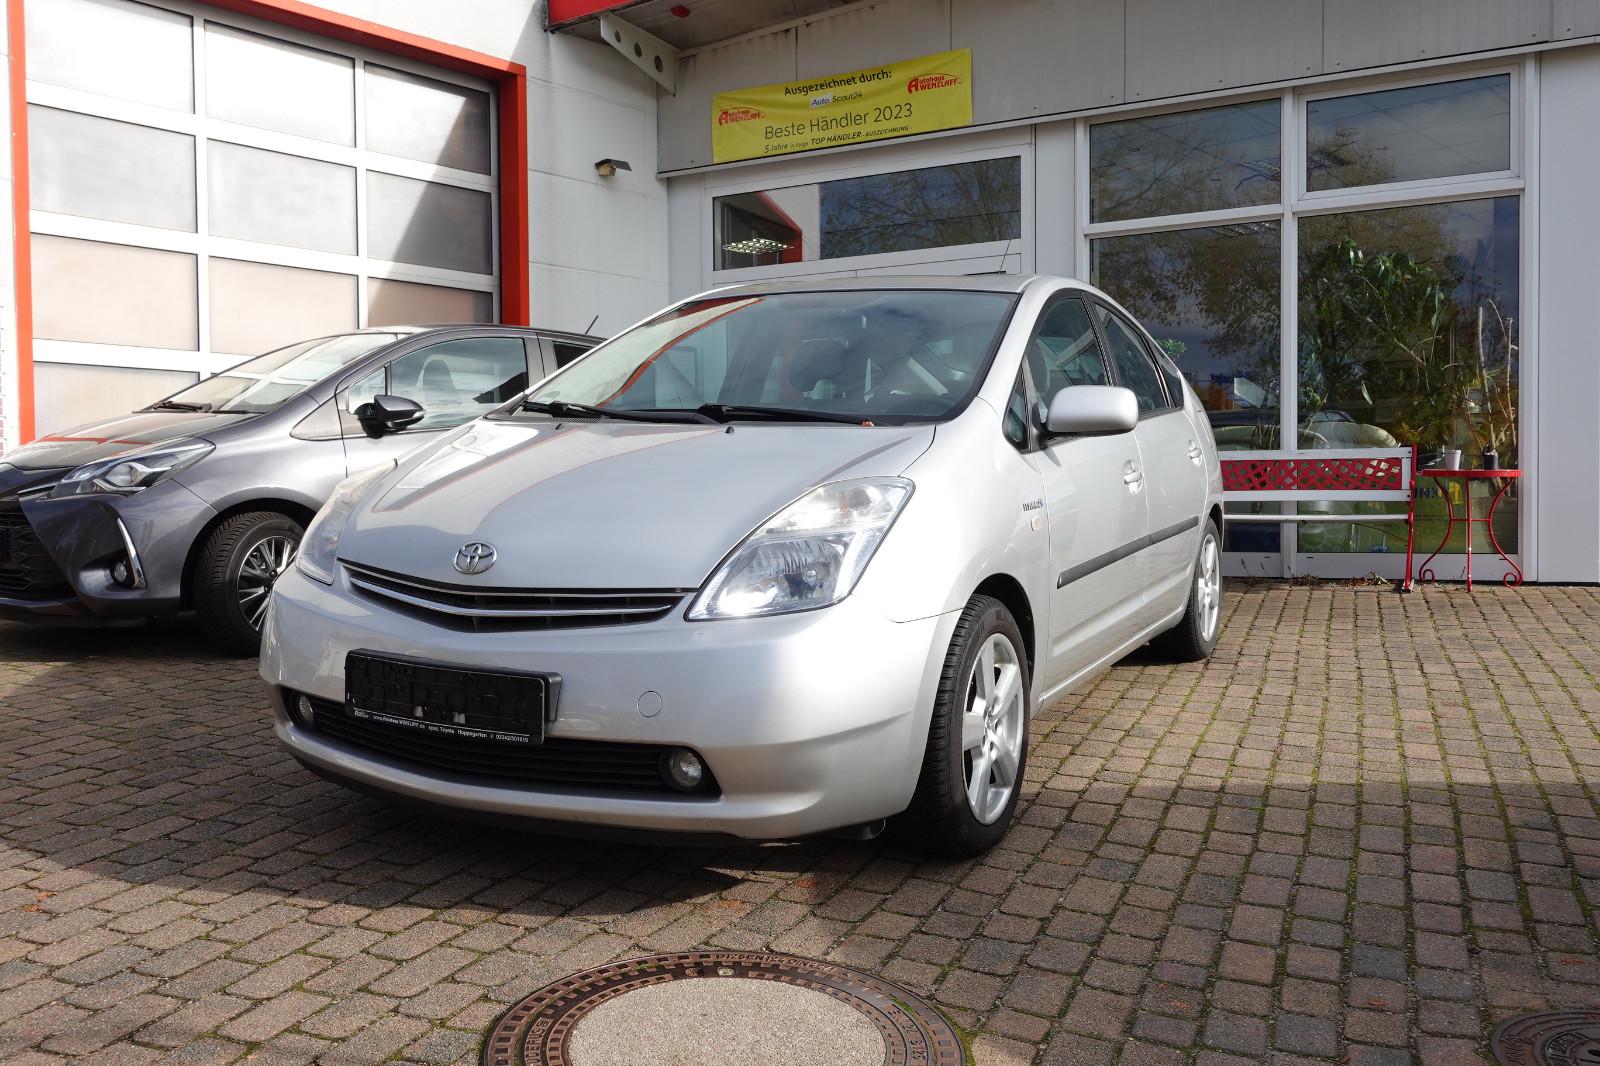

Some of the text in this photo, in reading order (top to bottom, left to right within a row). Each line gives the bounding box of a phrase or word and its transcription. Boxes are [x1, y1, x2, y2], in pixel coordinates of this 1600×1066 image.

[784, 69, 892, 96] Ausgezeichnet durch:
[919, 77, 959, 91] WENZLAFF
[764, 103, 913, 140] Beste Händler 2023
[764, 144, 770, 153] 5
[770, 142, 788, 152] Jahre
[811, 137, 826, 145] TOP
[457, 729, 487, 738] Hoppegarten
